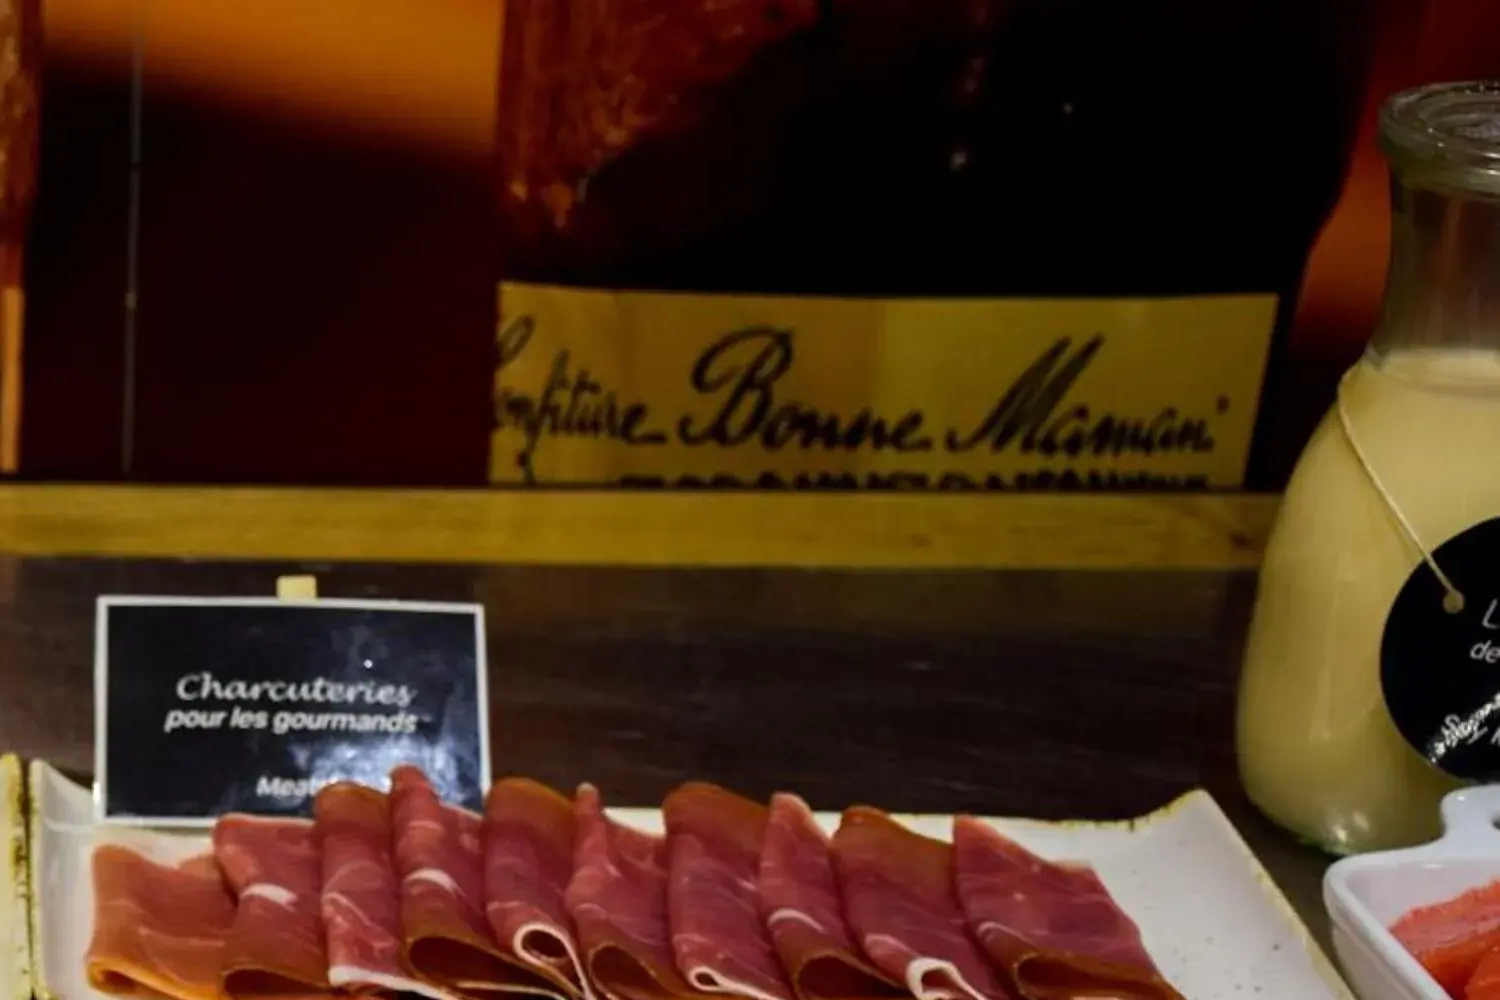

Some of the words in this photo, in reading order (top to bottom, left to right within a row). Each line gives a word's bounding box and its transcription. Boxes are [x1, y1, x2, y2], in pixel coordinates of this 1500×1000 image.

[676, 325, 933, 450] Bonne
[176, 670, 417, 707] Charcuteries
[163, 708, 227, 733] pour
[229, 705, 268, 729] les
[271, 709, 419, 735] gourmands
